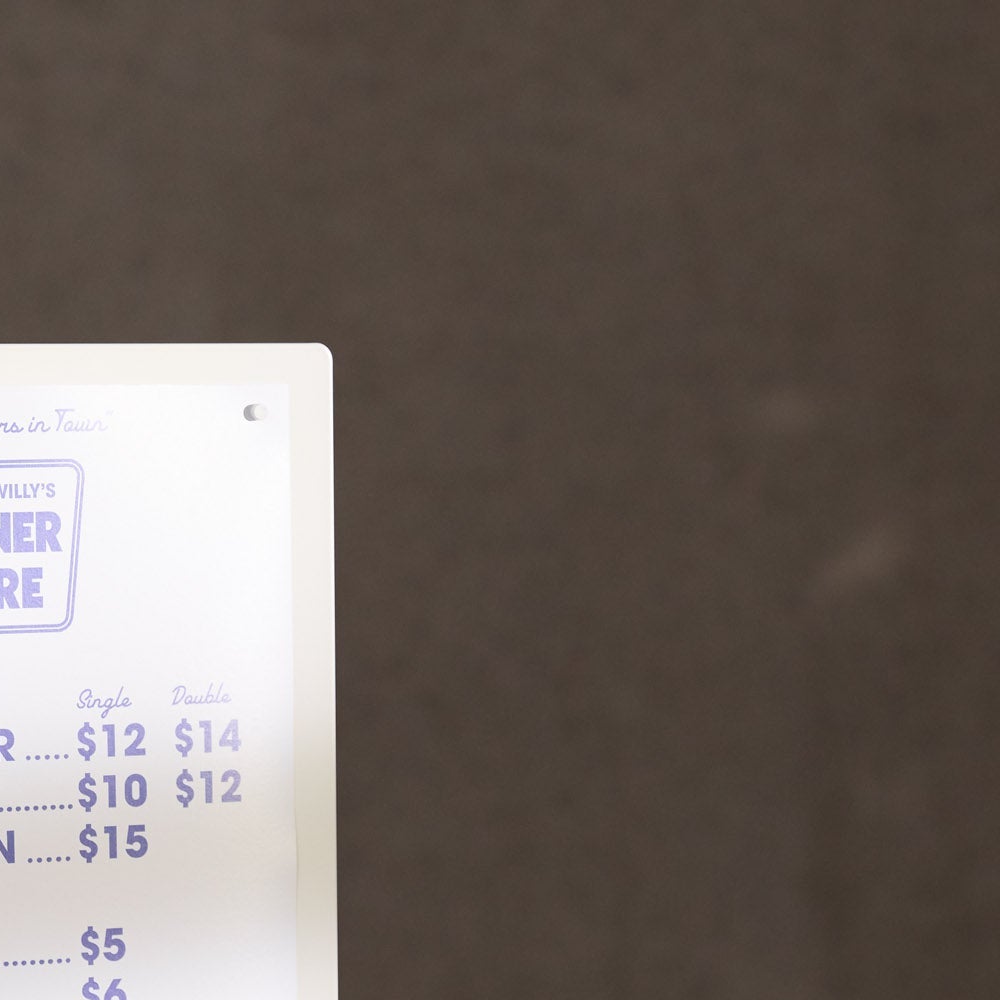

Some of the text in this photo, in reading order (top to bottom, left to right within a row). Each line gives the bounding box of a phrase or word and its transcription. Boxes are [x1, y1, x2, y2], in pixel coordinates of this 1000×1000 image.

[28, 416, 50, 433] in
[76, 682, 232, 719] Single Double
[77, 722, 147, 761] $12
[175, 718, 242, 757] $14
[78, 773, 147, 812] $10
[176, 770, 242, 808] $12
[79, 824, 148, 862] $15
[81, 926, 126, 966] $5
